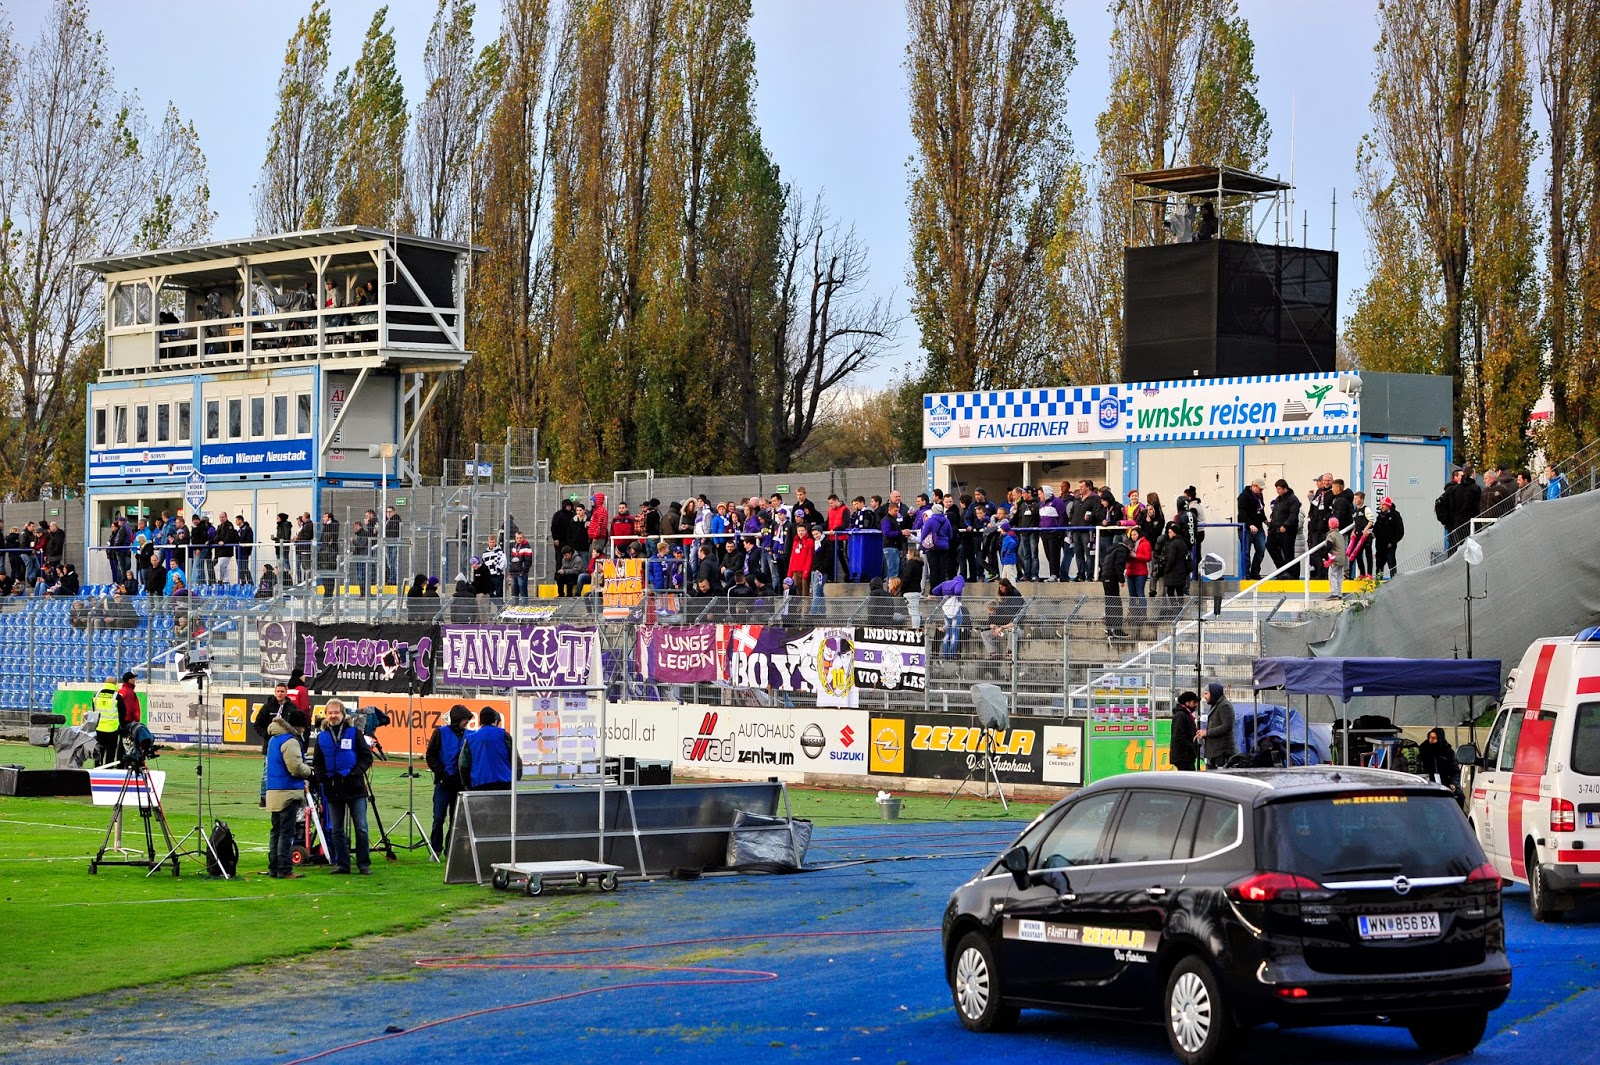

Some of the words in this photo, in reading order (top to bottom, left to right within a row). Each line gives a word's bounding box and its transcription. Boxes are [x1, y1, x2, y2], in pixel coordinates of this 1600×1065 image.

[330, 389, 346, 402] A1
[1137, 398, 1204, 429] wnsks
[1209, 395, 1277, 426] reisen
[977, 420, 1069, 439] FAN-CORNER
[202, 454, 233, 465] Stadion
[236, 452, 265, 463] Wiener
[266, 450, 307, 462] Neustadt
[1372, 463, 1389, 480] A1
[1186, 511, 1195, 545] adidas
[660, 633, 710, 653] JUNGE
[863, 628, 924, 644] INDUSTRY
[658, 650, 715, 671] LEGION
[863, 650, 875, 662] 20
[858, 671, 878, 684] VIO
[148, 699, 174, 709] Autohaus
[737, 723, 796, 739] AUTOHAUS
[803, 738, 824, 746] NISSAN
[911, 724, 1036, 756] ZEZULA
[829, 751, 865, 762] SUZUKI
[1023, 922, 1041, 930] WIENER
[1368, 918, 1388, 932] WN
[1395, 917, 1419, 931] 856
[1421, 916, 1437, 930] BX
[1021, 930, 1044, 938] NEUSTADT
[1047, 925, 1067, 938] FÄHRT
[1067, 929, 1079, 940] MIT
[1081, 926, 1146, 949] ZEZULA
